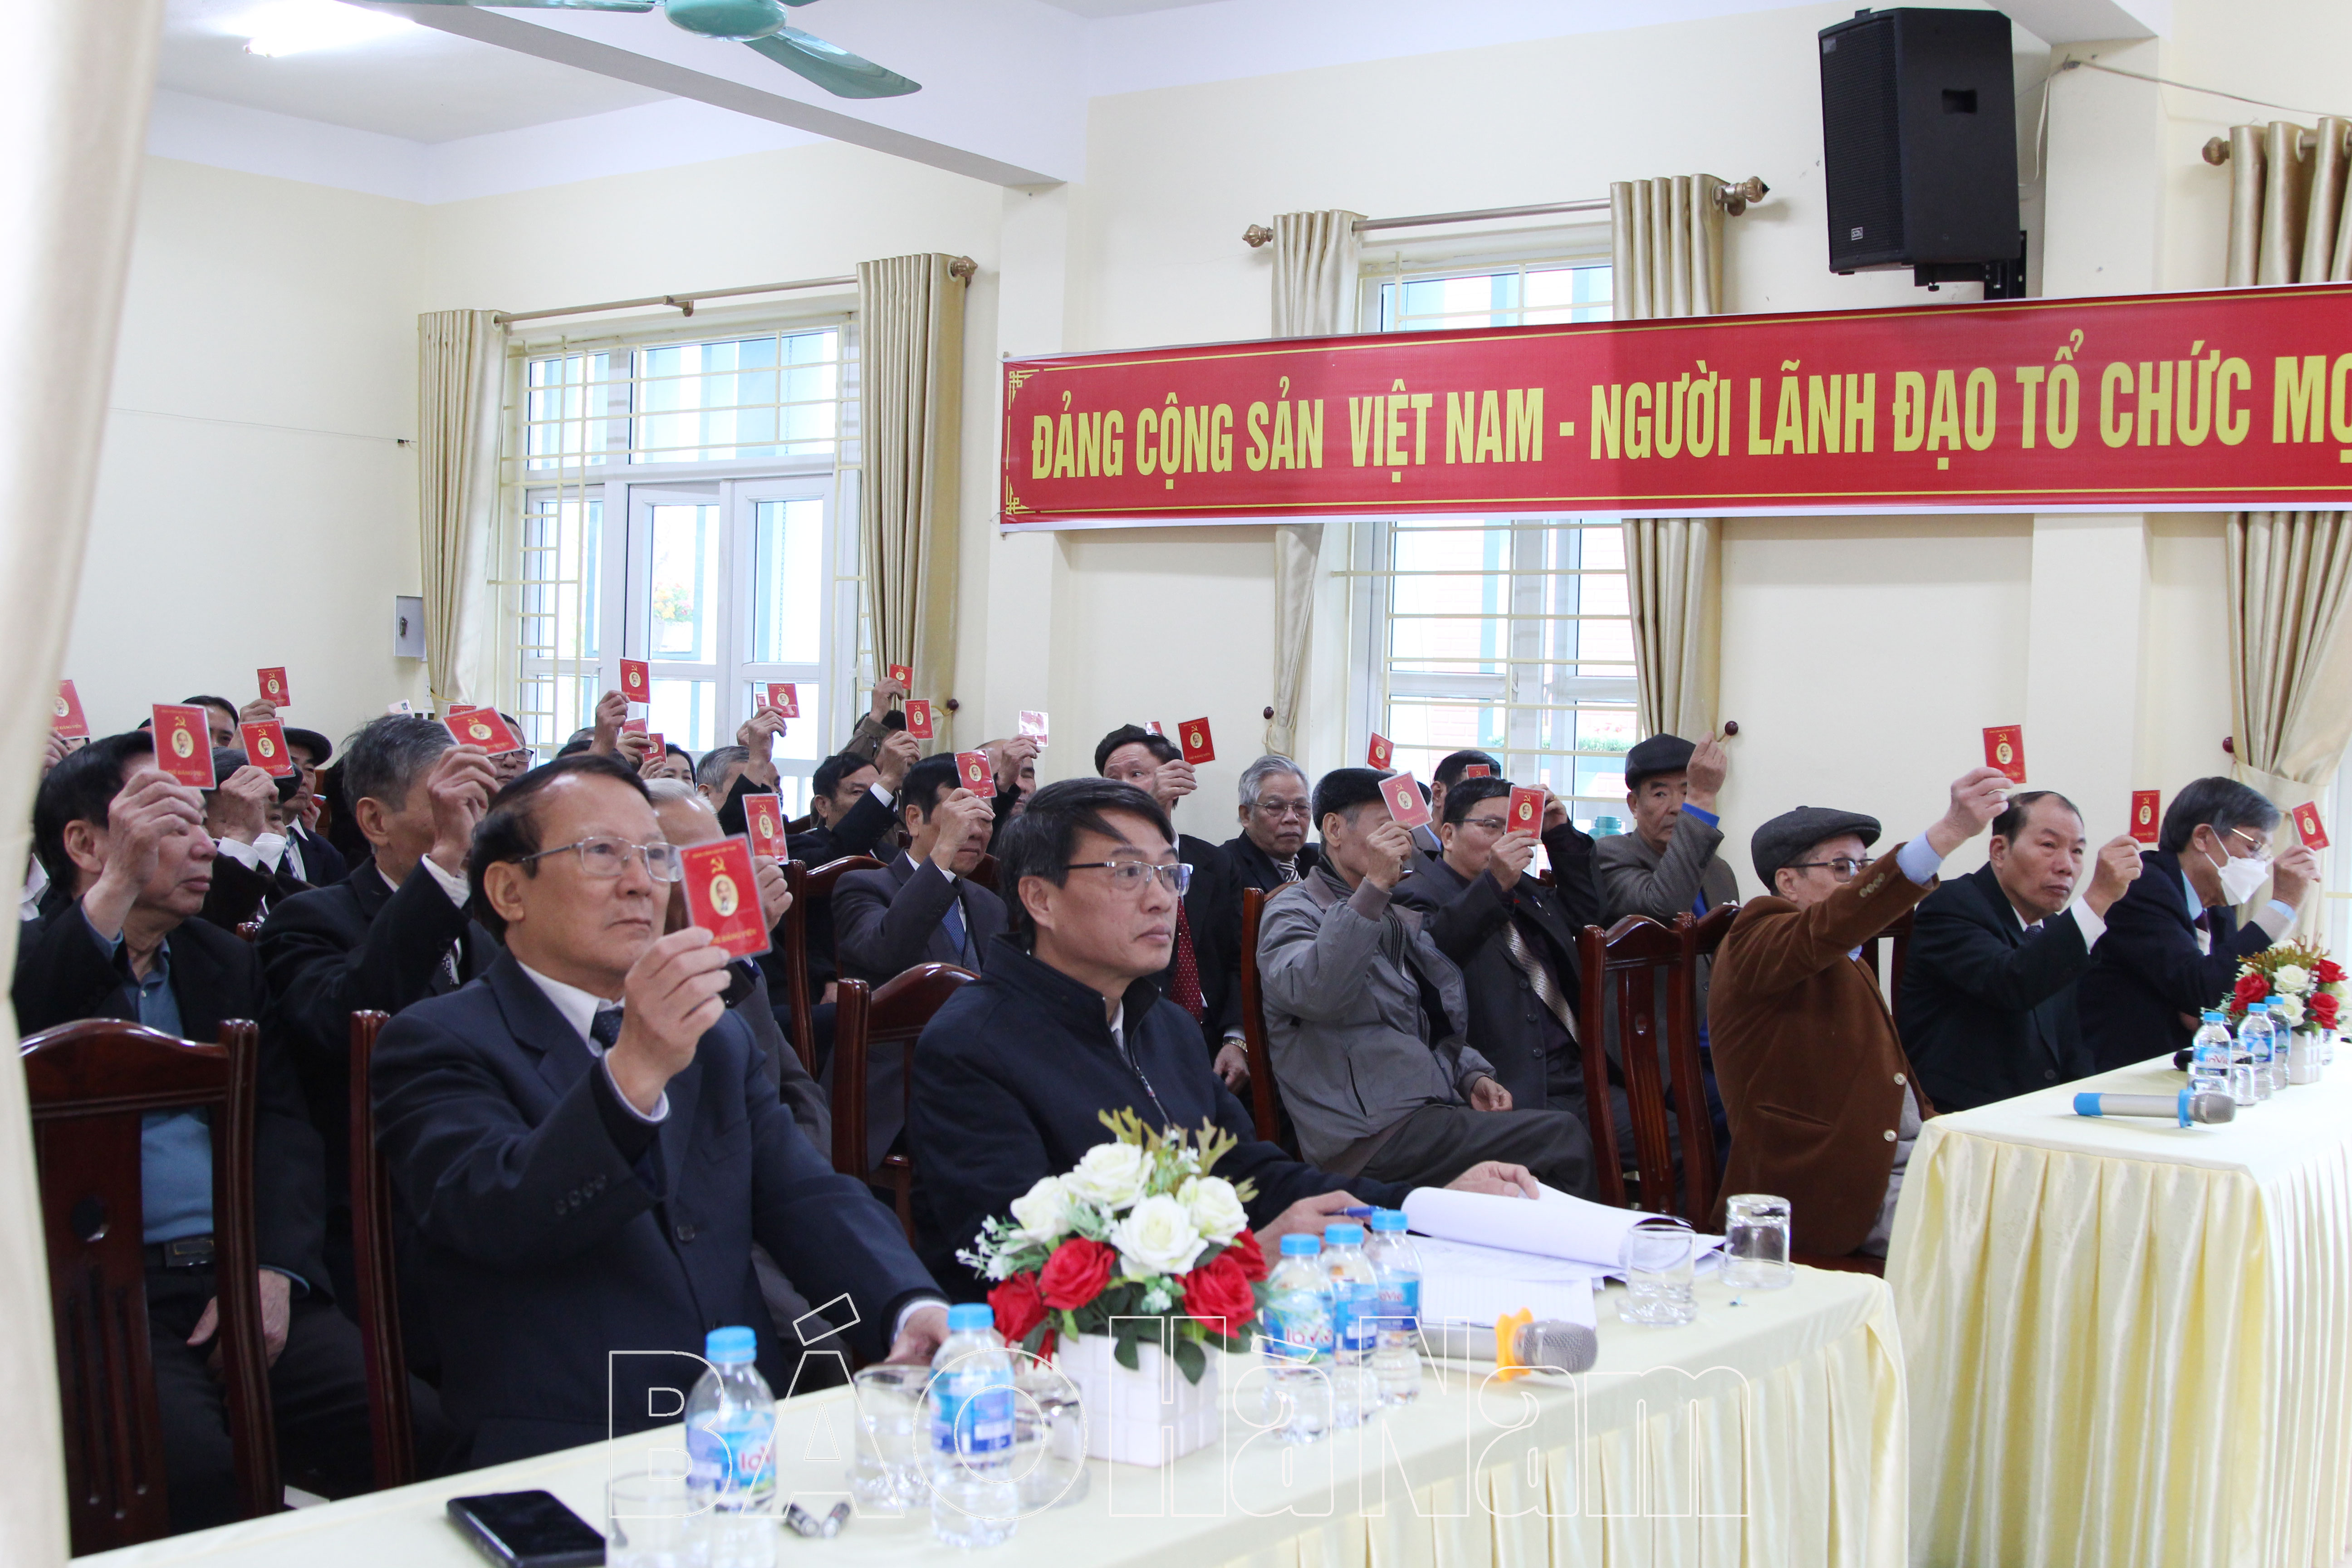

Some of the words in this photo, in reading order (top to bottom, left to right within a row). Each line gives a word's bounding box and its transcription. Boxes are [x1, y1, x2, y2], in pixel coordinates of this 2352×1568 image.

[1032, 391, 1124, 479] ĐẢNG
[1137, 392, 1233, 490] CỘNG
[1246, 377, 1323, 471] SẢN
[1350, 379, 1433, 483] VIỆT
[1446, 388, 1544, 464] NAM
[1591, 360, 1731, 460] NGƯỜI
[1749, 360, 1876, 455] LÃNH
[1893, 368, 1997, 470] ĐẠO
[2017, 329, 2084, 449] TỔ
[2101, 340, 2251, 448] CHỨC
